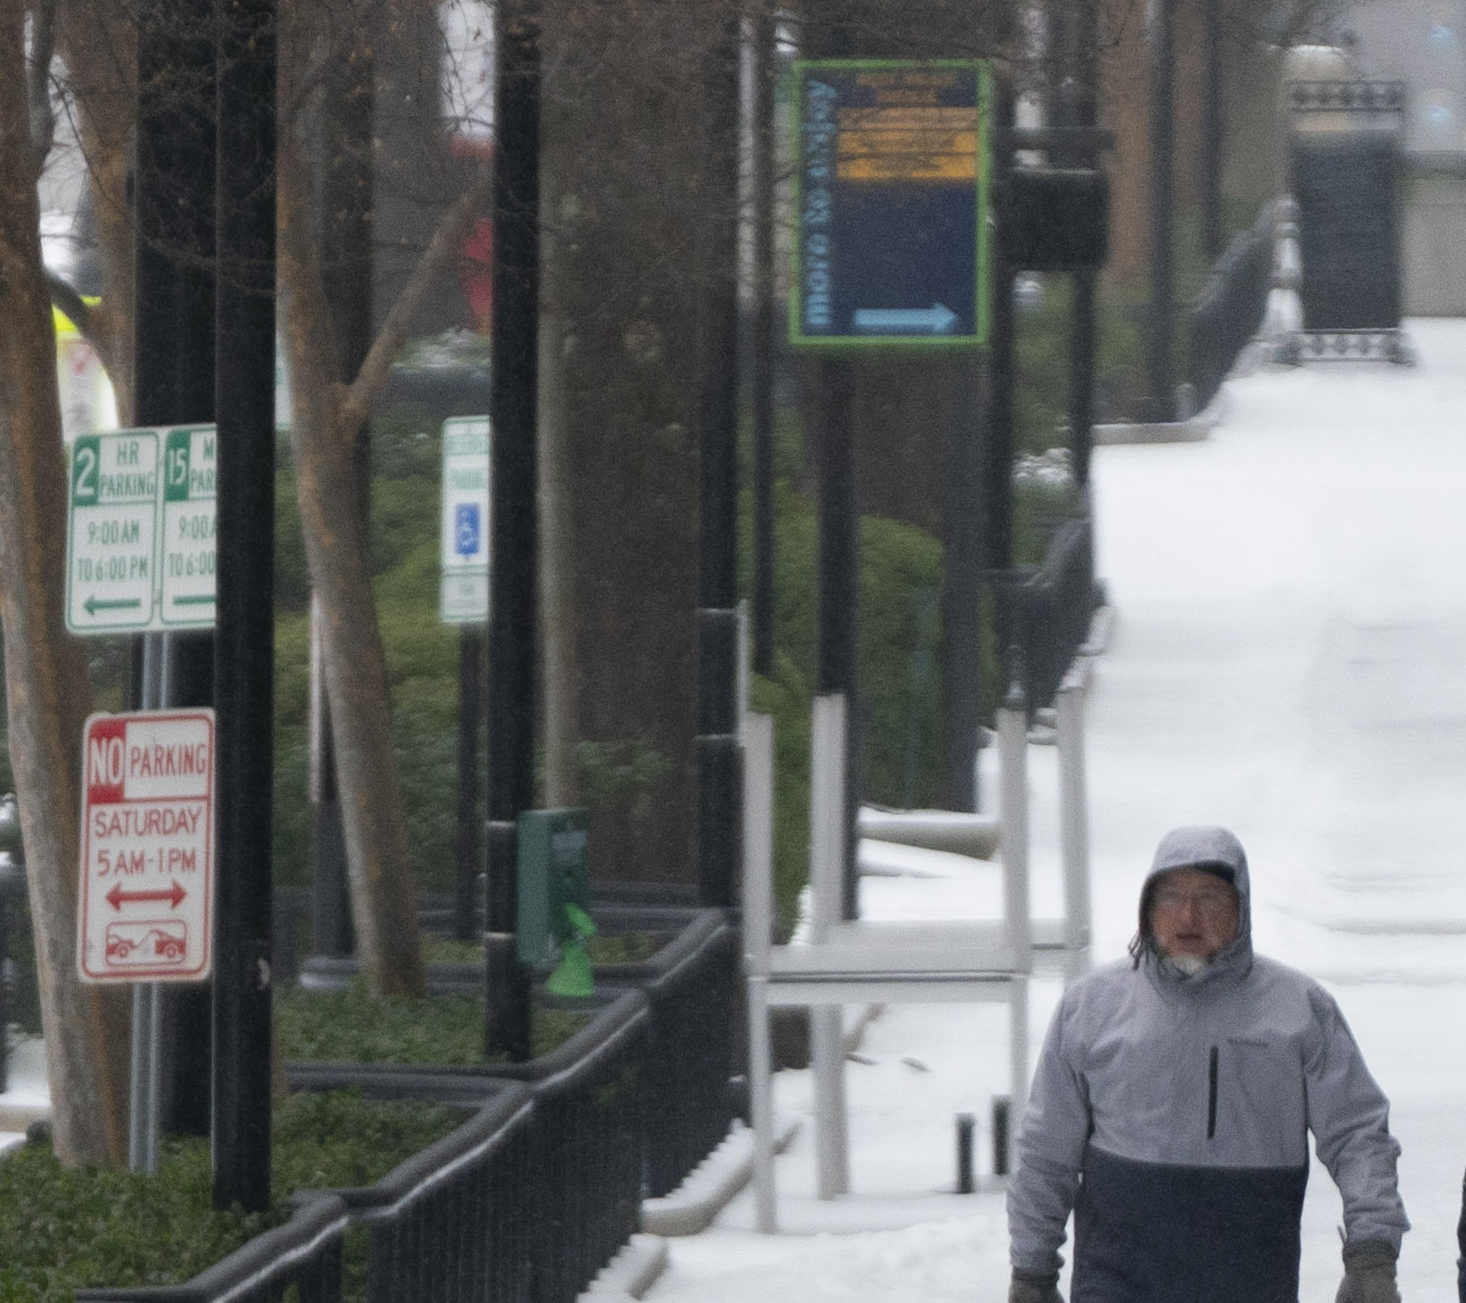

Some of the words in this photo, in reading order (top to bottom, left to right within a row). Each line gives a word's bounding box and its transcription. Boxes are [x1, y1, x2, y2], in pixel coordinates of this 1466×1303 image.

[76, 447, 95, 497] 2
[117, 441, 139, 465] HR
[168, 448, 187, 486] 15
[190, 466, 216, 493] PAR
[100, 471, 154, 497] PARKING
[77, 556, 92, 581] TO
[130, 554, 148, 578] PM
[90, 737, 124, 785] NO
[131, 744, 206, 777] PARKING
[94, 807, 202, 838] SATURDAY
